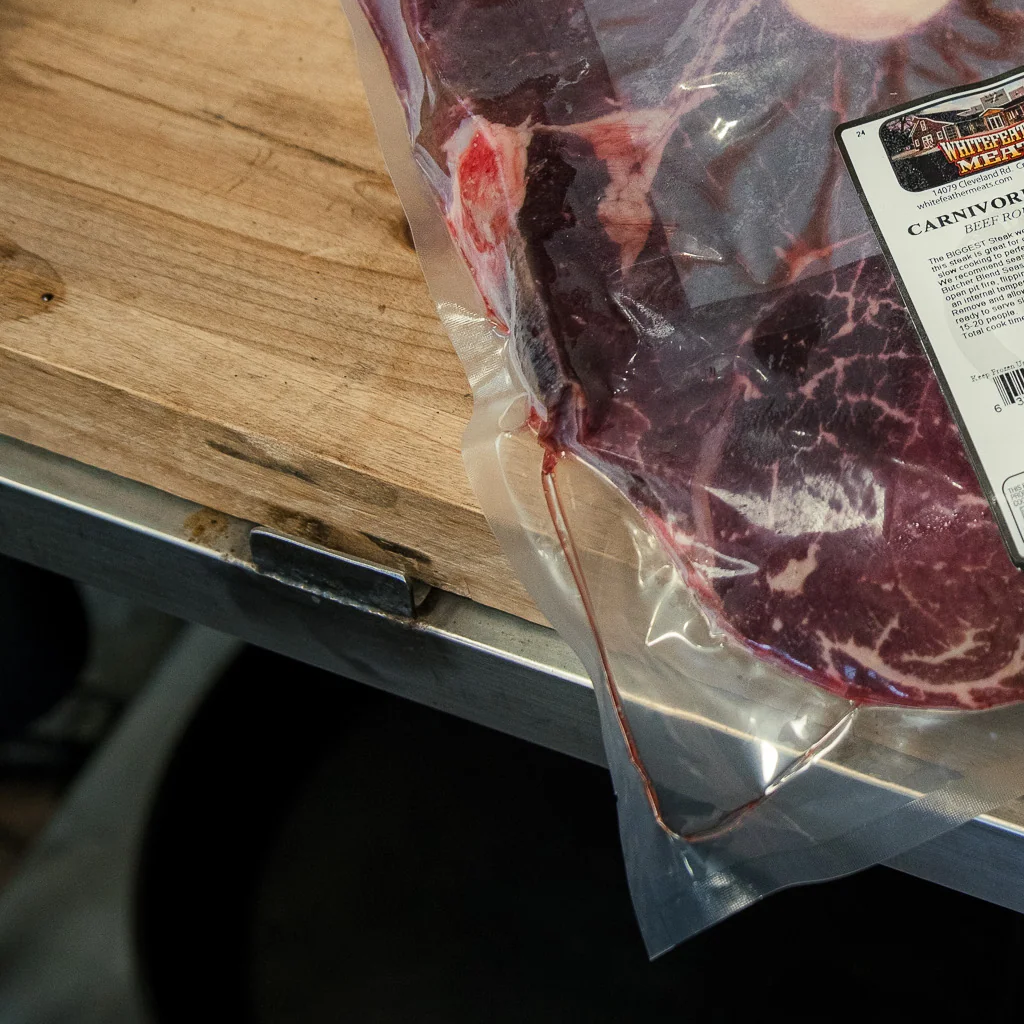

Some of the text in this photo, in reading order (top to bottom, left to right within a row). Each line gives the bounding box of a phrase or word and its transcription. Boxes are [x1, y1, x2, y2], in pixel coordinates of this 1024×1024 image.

[855, 129, 866, 138] 24
[916, 175, 1013, 210] whitefeathermeats.com
[931, 182, 958, 196] 14079
[957, 169, 999, 188] Cleveland
[963, 214, 999, 234] BEEF
[927, 255, 945, 265] The
[945, 239, 986, 259] BIGGEST
[987, 232, 1013, 244] Steak
[930, 263, 948, 273] this
[948, 253, 972, 266] steak
[973, 250, 983, 258] is
[984, 242, 1006, 255] great
[1006, 238, 1019, 247] for
[937, 267, 957, 278] slow
[958, 255, 993, 271] cooking
[992, 252, 1003, 260] to
[937, 277, 953, 286] We
[954, 259, 1004, 281] recommend
[940, 277, 974, 294] Butcher
[974, 268, 1001, 282] Blend
[944, 289, 967, 301] open
[967, 283, 980, 294] pit
[950, 300, 987, 316] Remove
[988, 293, 1005, 304] and
[951, 299, 963, 308] an
[963, 287, 996, 303] internal
[954, 311, 979, 324] ready
[980, 308, 990, 316] to
[991, 301, 1015, 311] serve
[962, 326, 984, 339] Total
[985, 320, 1007, 332] cook
[992, 402, 1004, 414] 6
